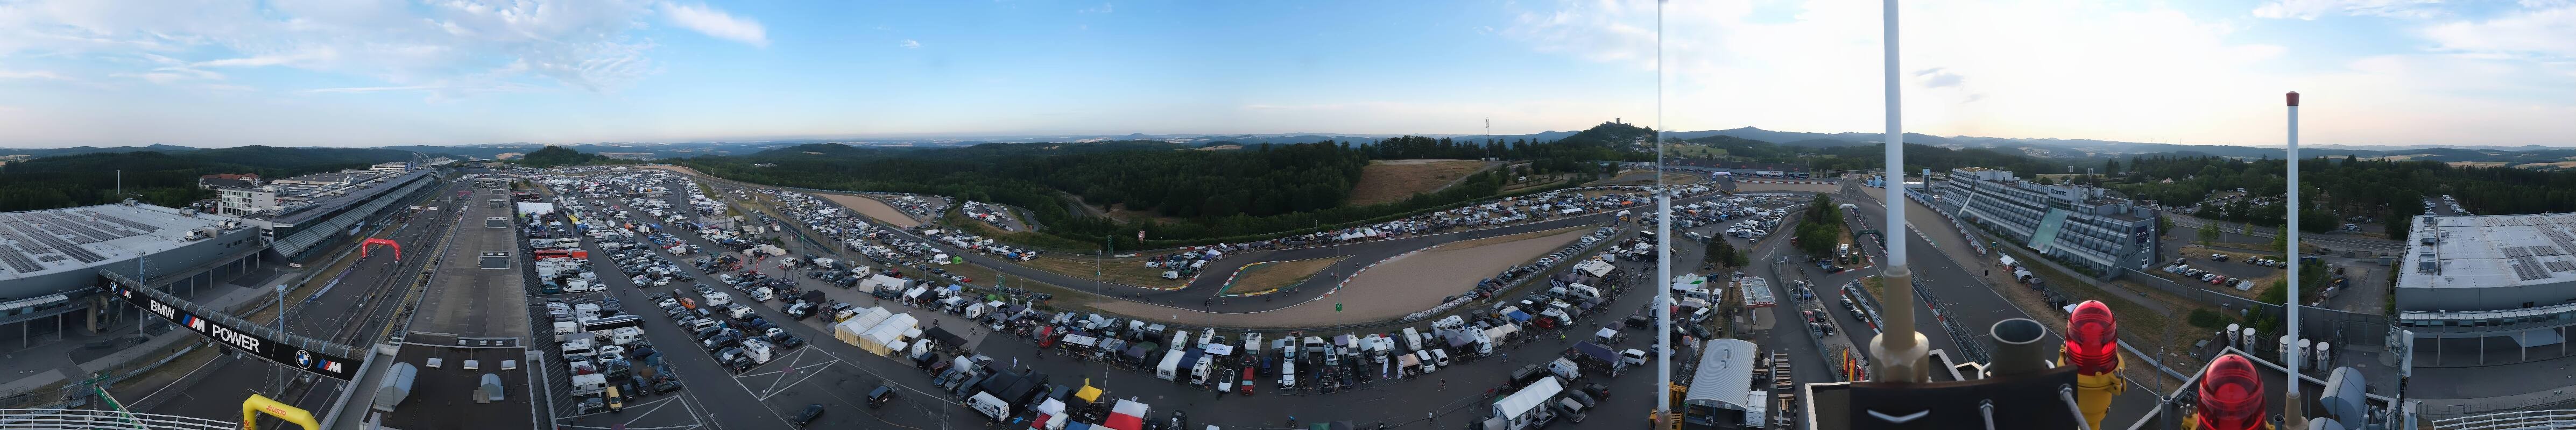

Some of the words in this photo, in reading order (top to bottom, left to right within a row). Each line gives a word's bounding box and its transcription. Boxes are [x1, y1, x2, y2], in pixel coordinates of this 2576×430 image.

[2051, 188, 2066, 196] Dorint
[151, 299, 175, 319] BMW
[213, 324, 259, 353] POWER
[272, 407, 286, 416] LOTTO
